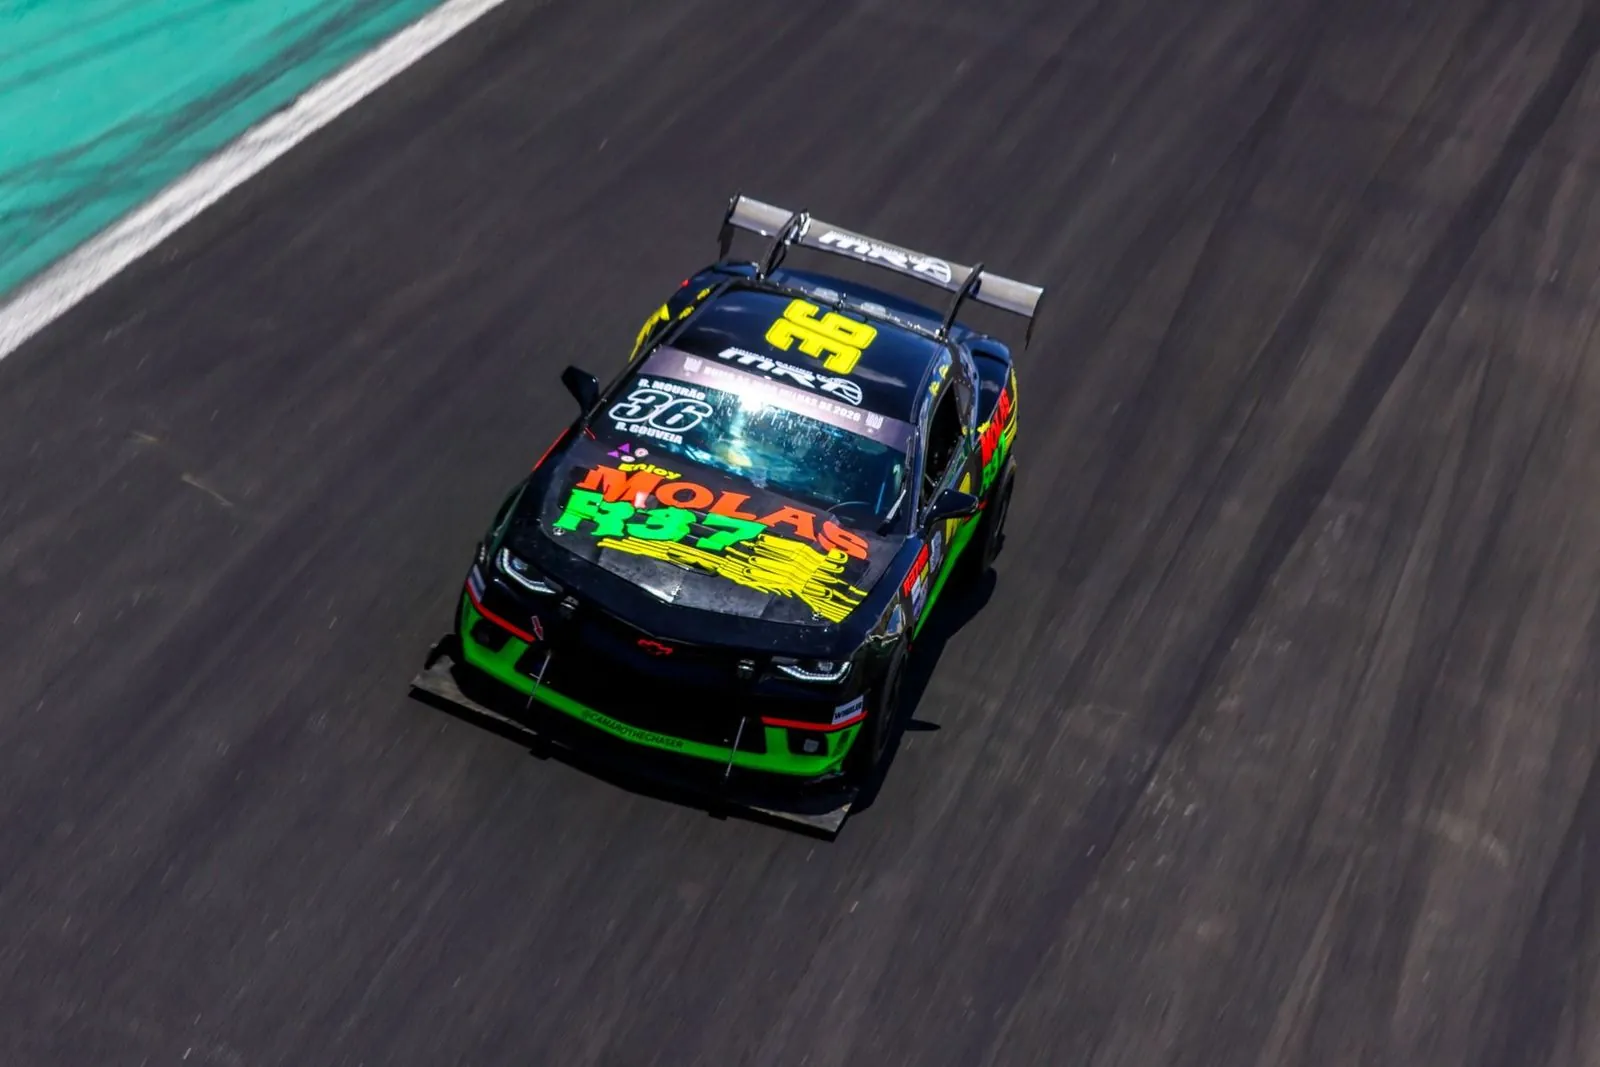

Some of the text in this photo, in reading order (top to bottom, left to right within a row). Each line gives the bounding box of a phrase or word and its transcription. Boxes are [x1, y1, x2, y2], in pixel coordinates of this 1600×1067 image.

[765, 298, 878, 375] 36
[608, 388, 713, 432] 36
[638, 378, 706, 400] R. MOURÃO
[615, 421, 683, 444] R. GOUVEIA
[833, 404, 861, 422] 2026
[553, 489, 767, 551] R37
[576, 464, 869, 560] MOLAS
